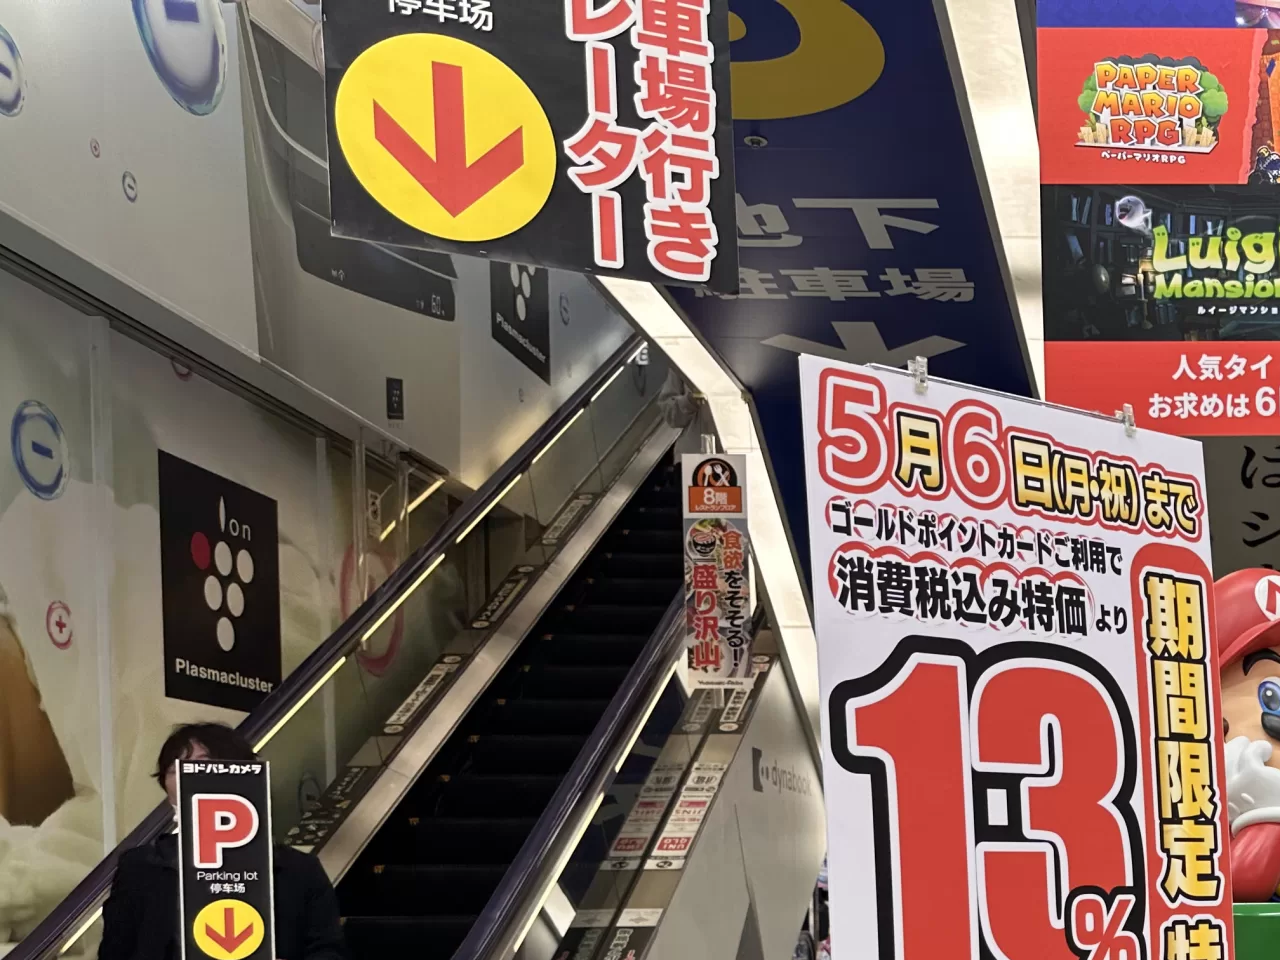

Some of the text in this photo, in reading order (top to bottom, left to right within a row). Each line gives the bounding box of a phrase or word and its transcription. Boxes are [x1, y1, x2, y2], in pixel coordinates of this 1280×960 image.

[1095, 62, 1203, 94] PAPER
[1092, 90, 1202, 118] MARIO
[1109, 118, 1181, 146] RPG
[1101, 151, 1186, 164] ペーパーマリオRPG
[496, 312, 547, 364] Plasmacluster
[831, 500, 1123, 577] ゴールドポイントカードご利用で
[836, 553, 1129, 637] 消費税込み特価 より
[692, 563, 720, 668] 盛り沢山
[175, 657, 274, 694] Plasmacluster
[1143, 572, 1221, 903] 期間限定
[183, 763, 262, 775] ヨドバシカメラ
[191, 793, 260, 869] P
[196, 869, 258, 883] Parking lot
[210, 882, 246, 894] 停车场
